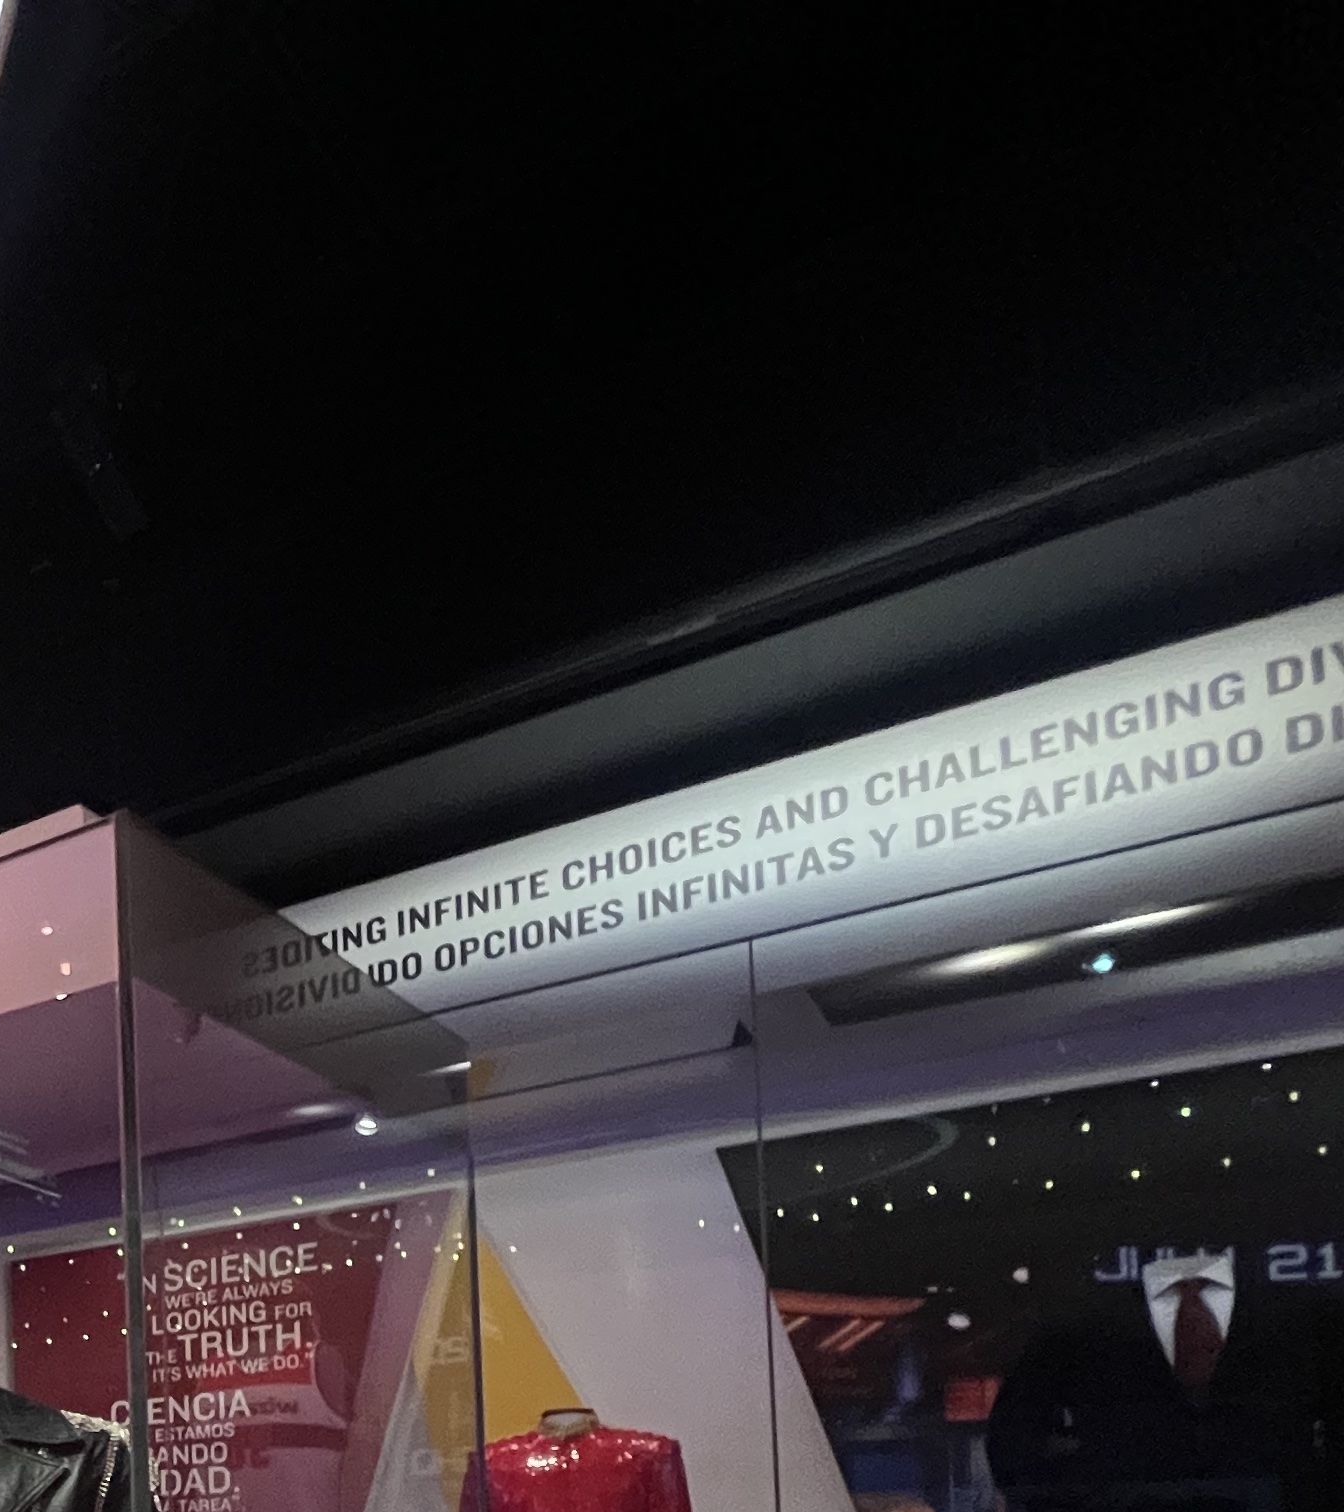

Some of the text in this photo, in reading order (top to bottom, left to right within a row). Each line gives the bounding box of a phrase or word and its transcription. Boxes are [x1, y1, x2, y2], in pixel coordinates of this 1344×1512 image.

[396, 869, 549, 937] INFINITE
[562, 815, 741, 893] CHOICES
[755, 786, 849, 841] AND
[864, 671, 1247, 807] CHALLENGING
[434, 898, 624, 972] OPCIONES
[637, 837, 856, 922] INFINITAS
[868, 823, 898, 860] Y
[916, 727, 1264, 850] DESAFIANDO
[165, 1279, 294, 1309] WE'RE ALWAYS
[152, 1300, 312, 1336] LOOKING FOR
[145, 1320, 313, 1366] THE TRUTH.
[153, 1368, 181, 1383] IT'S
[185, 1361, 237, 1379] WHAT
[240, 1357, 270, 1374] WE
[110, 1389, 252, 1427] CENCIA
[155, 1422, 236, 1443] ESTAMOS
[154, 1441, 229, 1466] ANDO
[160, 1465, 241, 1497] DAD.
